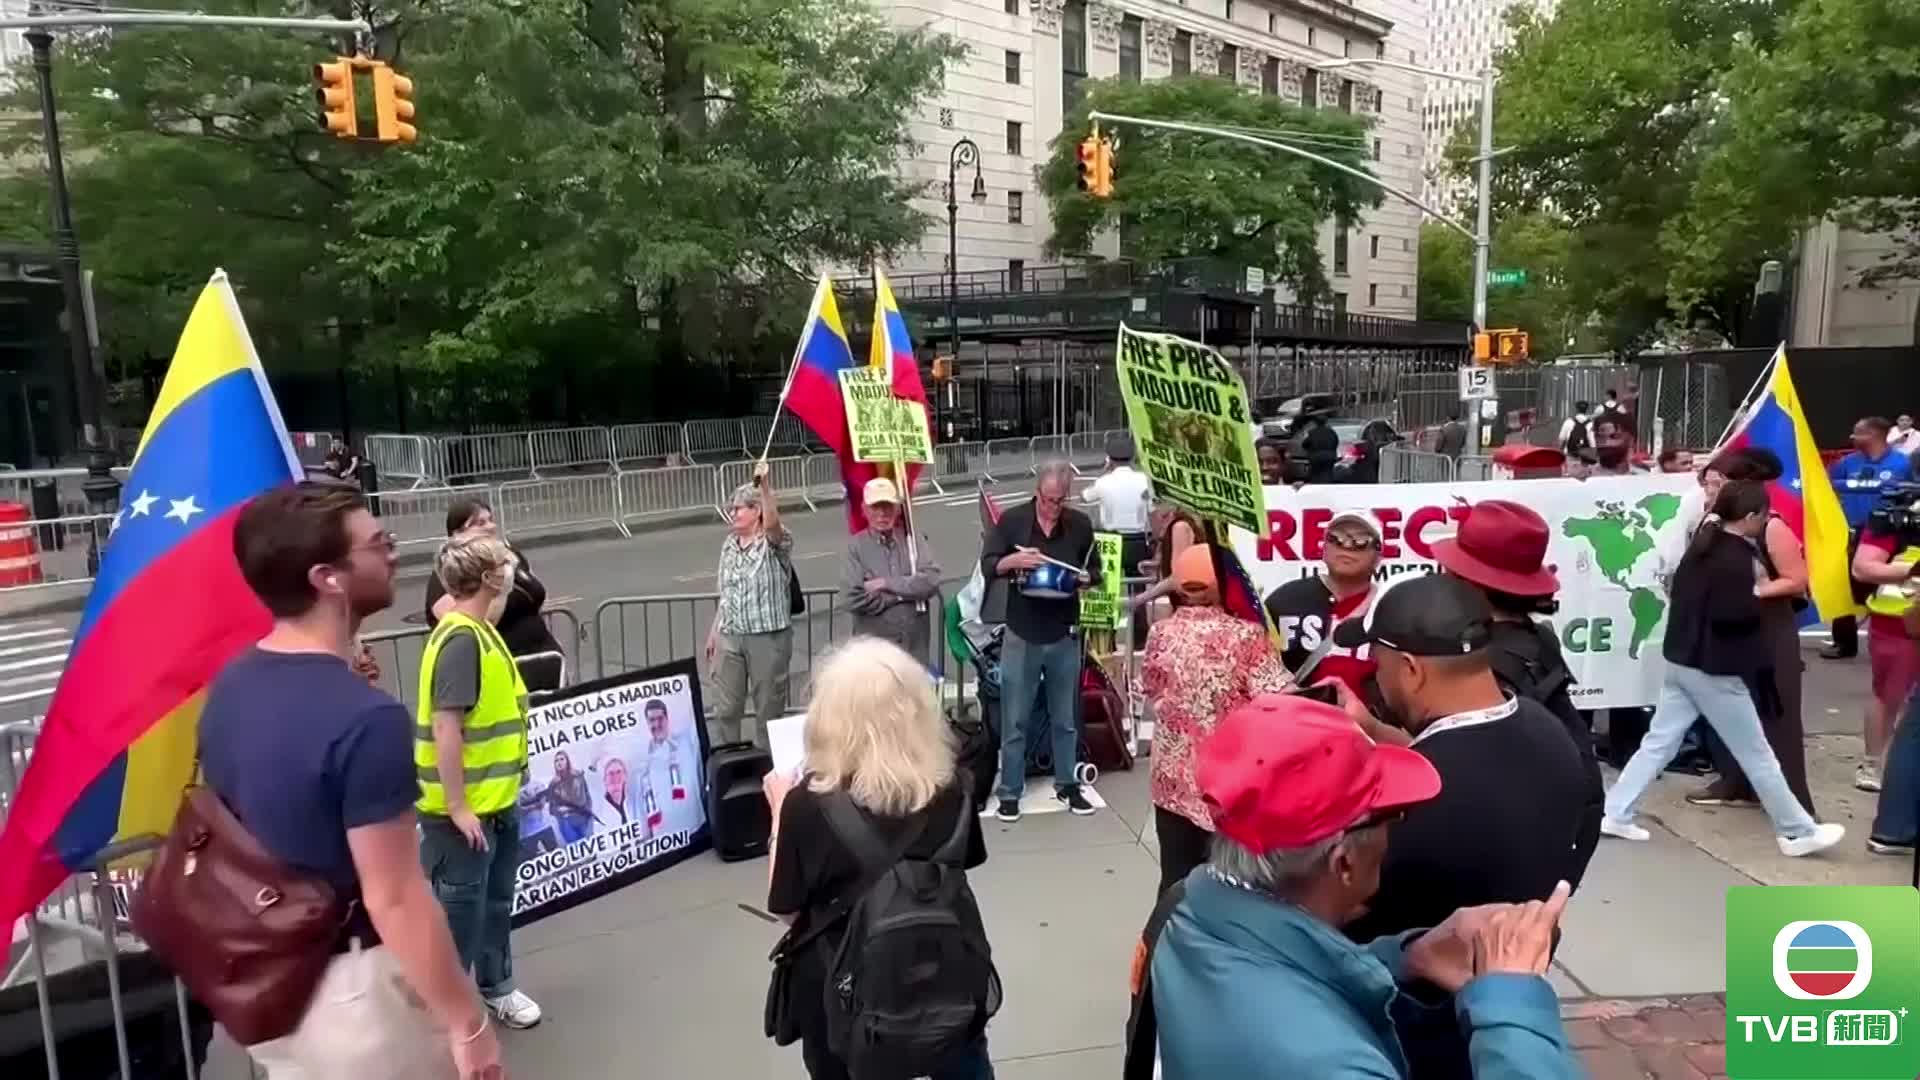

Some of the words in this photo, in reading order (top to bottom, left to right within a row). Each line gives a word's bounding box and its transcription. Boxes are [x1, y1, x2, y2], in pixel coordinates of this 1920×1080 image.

[1122, 329, 1166, 374] FREE
[1168, 343, 1238, 387] PRES.
[1468, 370, 1487, 386] 15
[1127, 367, 1222, 416] MADURO
[1229, 395, 1245, 423] &
[1149, 458, 1188, 489] CILIA
[1191, 473, 1254, 508] FLORES
[1174, 450, 1252, 486] COMBATANT
[1256, 506, 1472, 561] REEC
[544, 693, 616, 725] NICOLAS
[619, 679, 683, 705] MADURO
[573, 712, 638, 743] FLORES
[516, 851, 566, 884] ONG
[569, 835, 606, 863] LIVE
[609, 822, 642, 848] THE
[580, 829, 691, 884] REVOLUTION!
